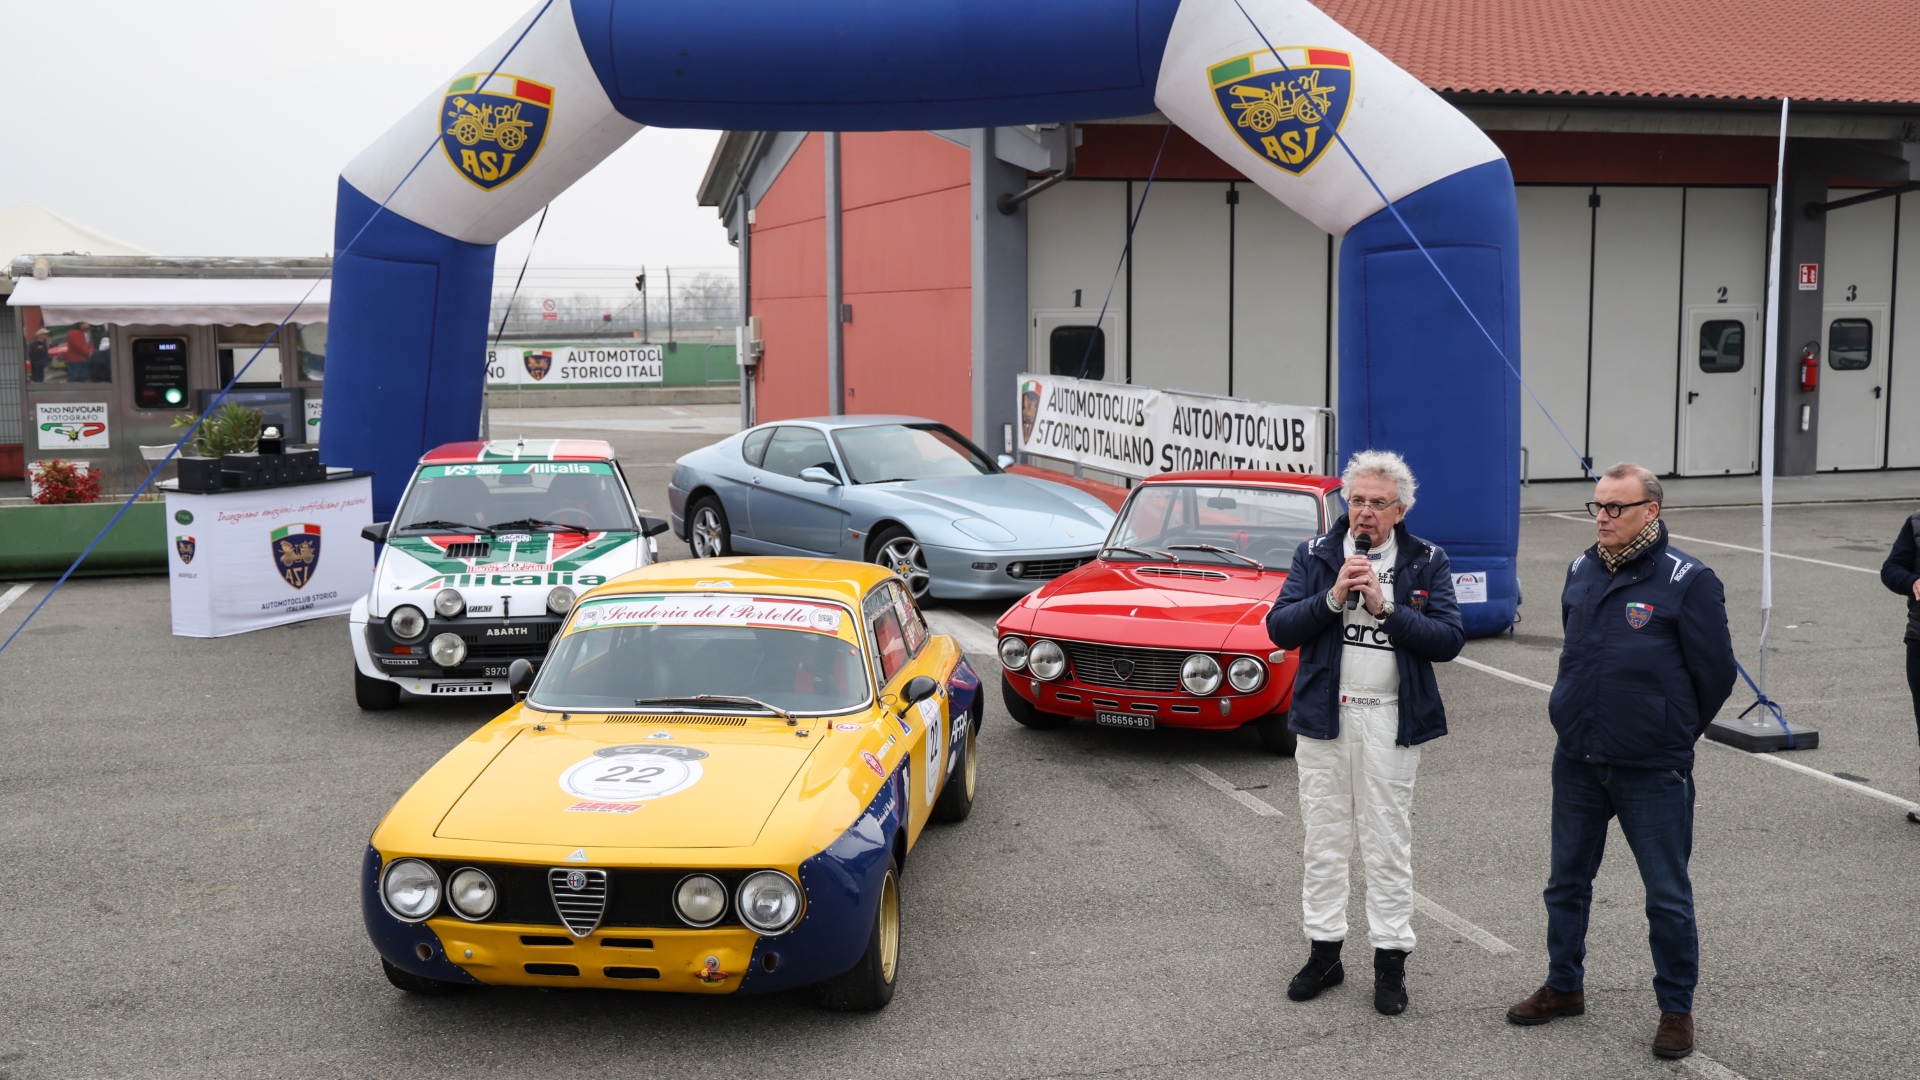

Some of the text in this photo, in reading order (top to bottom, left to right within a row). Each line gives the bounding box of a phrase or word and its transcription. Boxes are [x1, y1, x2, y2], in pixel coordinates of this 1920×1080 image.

[1260, 126, 1320, 164] ASI
[460, 148, 516, 181] ASI
[1072, 289, 1082, 308] 1
[1717, 286, 1728, 304] 2
[1846, 284, 1857, 302] 3
[561, 366, 622, 378] STORICO
[1047, 386, 1144, 427] AUTOMOTOCLUB
[1036, 419, 1090, 453] STORICO
[1094, 428, 1154, 466] ITALIANO
[444, 466, 471, 475] VS
[524, 464, 590, 474] Alitalia
[408, 571, 606, 590] Alitalia
[262, 591, 338, 610] AUTOMOTOCLUB STORICO
[286, 603, 314, 613] ITALIANO
[603, 605, 688, 620] Scuderia
[694, 604, 730, 618] del
[730, 605, 807, 622] Portello
[486, 628, 528, 636] ABARTH
[485, 667, 510, 675] S970
[431, 682, 493, 694] PIRELLI
[1351, 697, 1380, 705] A.SCURO
[595, 766, 665, 784] 22
